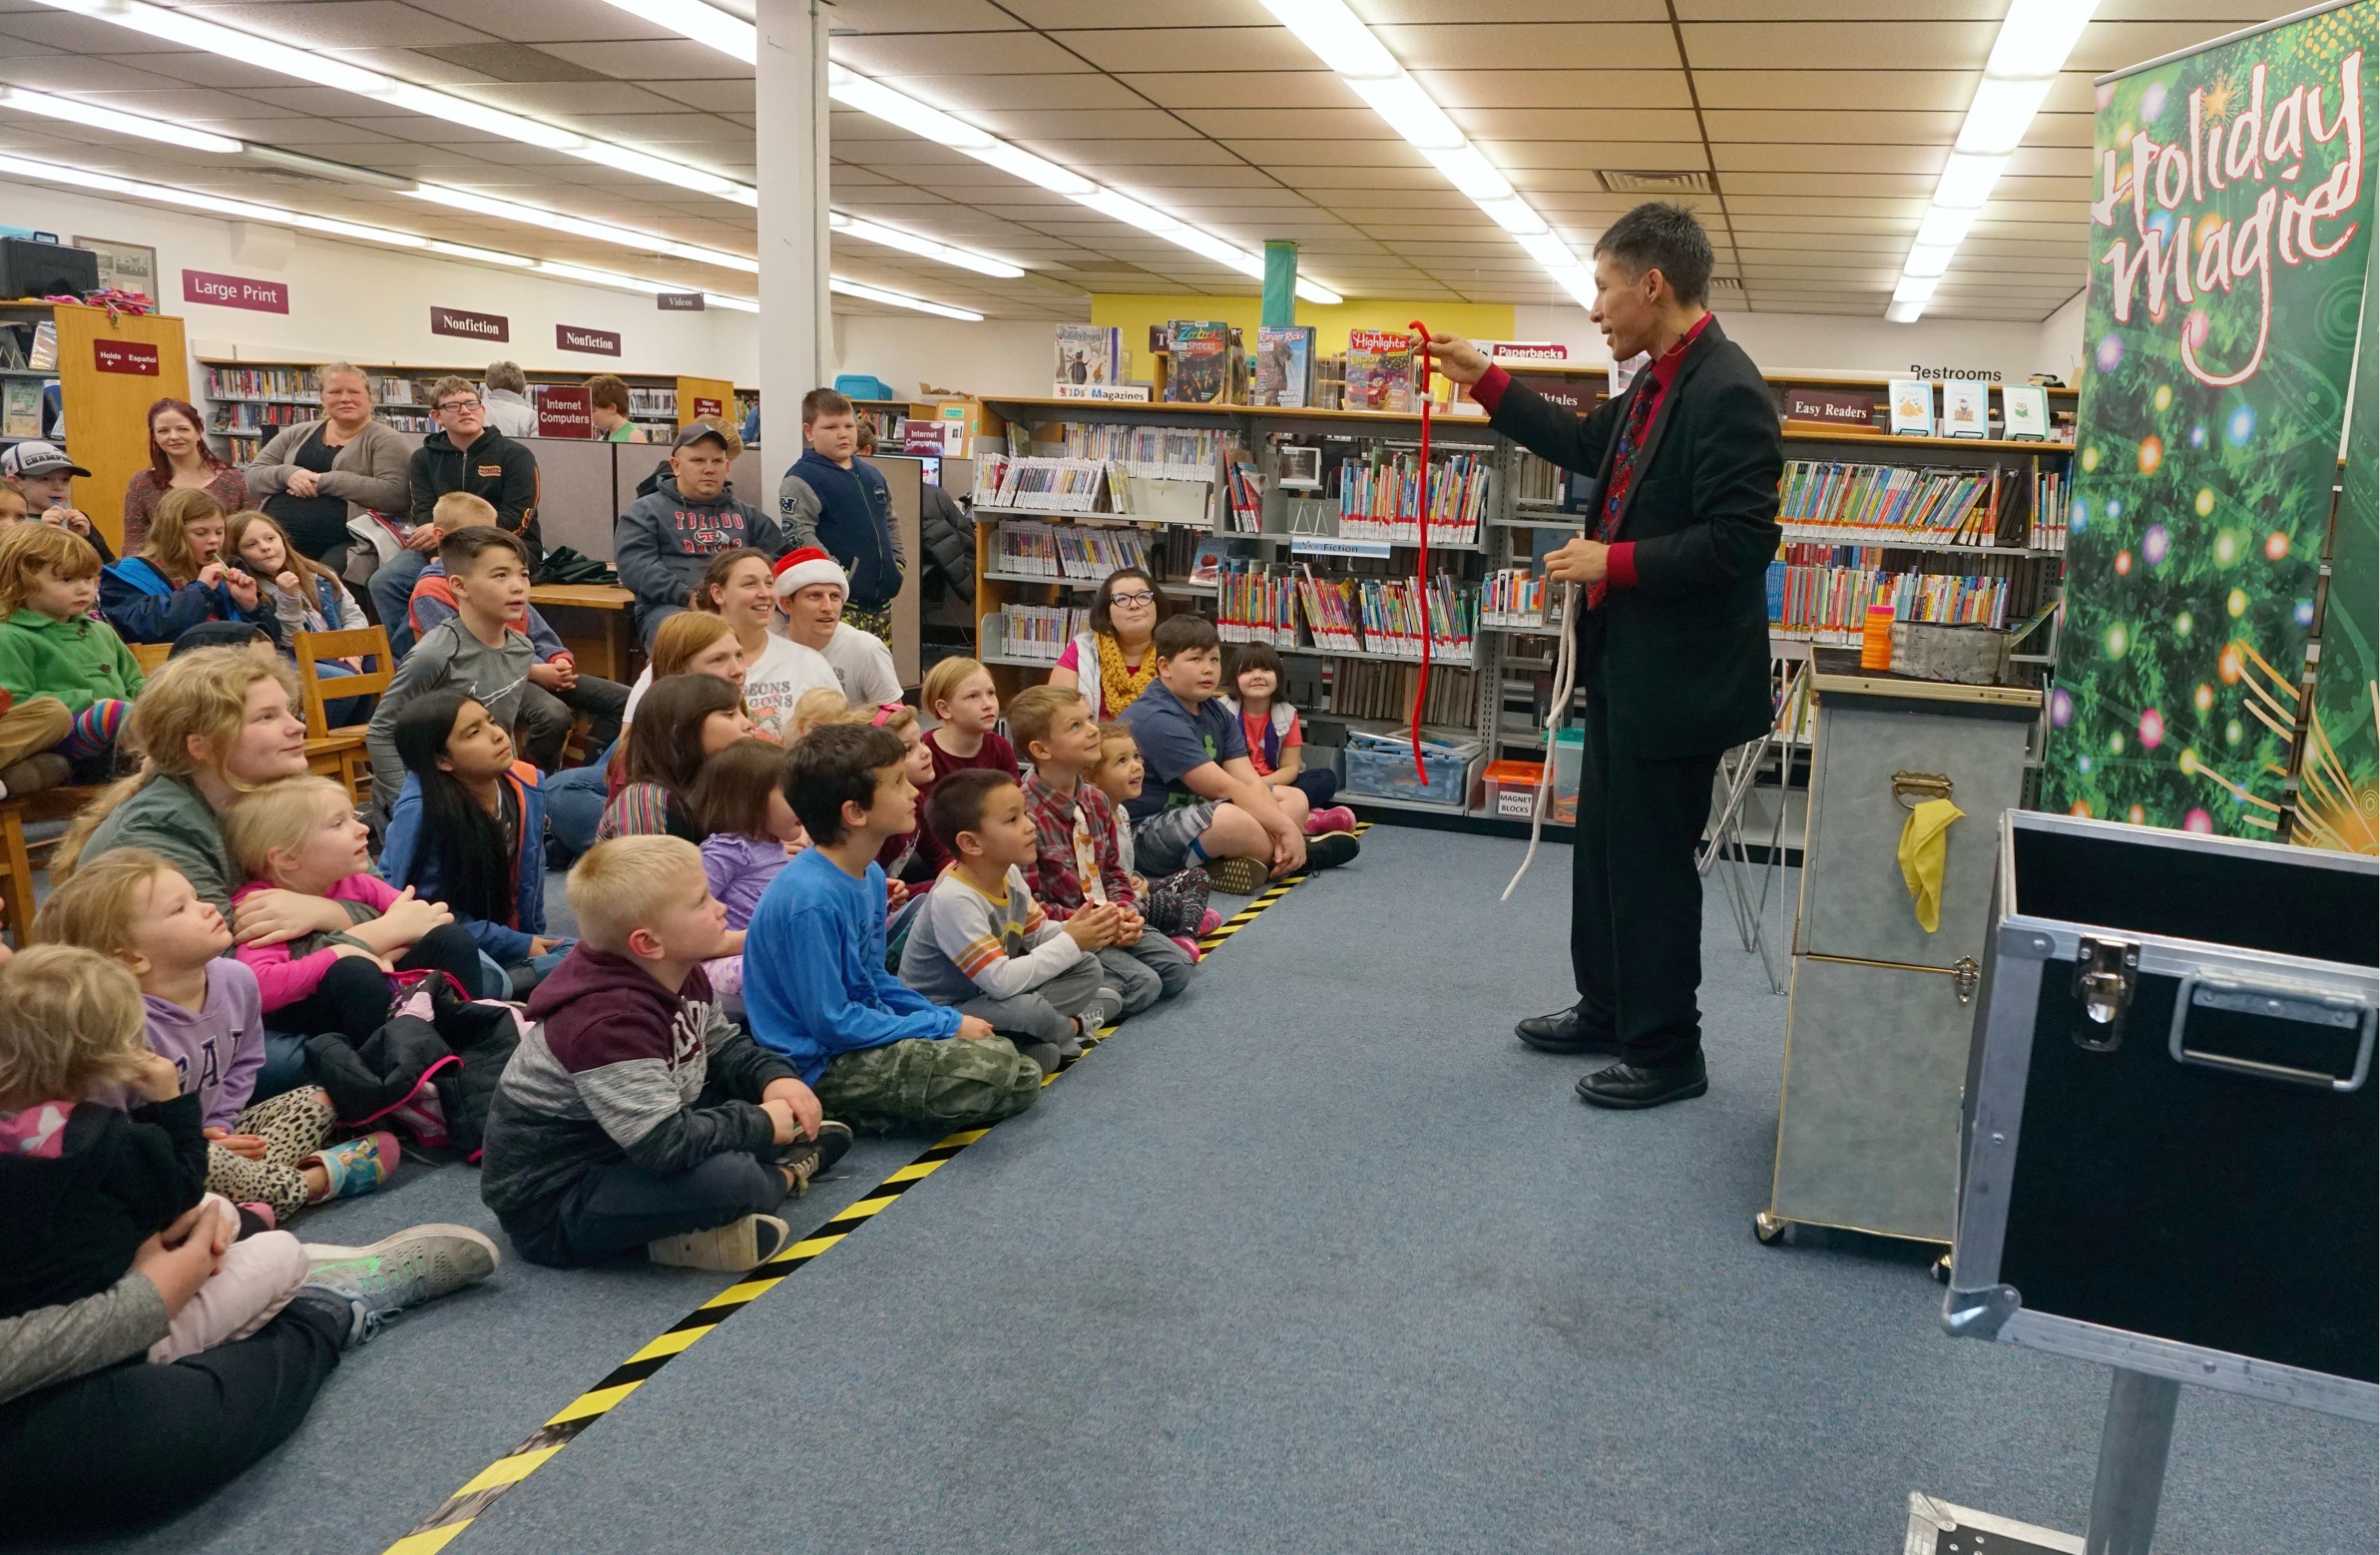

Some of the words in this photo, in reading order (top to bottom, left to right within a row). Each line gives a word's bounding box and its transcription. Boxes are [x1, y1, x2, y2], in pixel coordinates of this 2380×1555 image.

[2091, 49, 2364, 238] Holiday
[195, 277, 238, 300] Large
[243, 284, 277, 303] Print
[669, 296, 694, 307] Videos
[443, 314, 500, 335] Nonfiction
[566, 331, 613, 350] Nonfiction
[1259, 331, 1284, 342] Ranger
[1353, 332, 1406, 350] Highlights
[1188, 341, 1215, 350] SPIDERS
[100, 351, 122, 360] Holds
[129, 354, 157, 363] Español
[1499, 346, 1564, 359] Paperbacks
[1910, 364, 2002, 381] Restrooms
[1092, 388, 1145, 401] Magazines
[1540, 392, 1578, 406] ktales
[547, 398, 582, 411] Internet
[1795, 400, 1821, 416] Easy
[1825, 404, 1867, 419] Readers
[540, 411, 590, 426] Computers
[911, 429, 938, 438] Internet
[905, 439, 943, 448] Computers
[675, 511, 744, 530] TOLEDO
[1323, 543, 1358, 553] Fiction
[1500, 794, 1532, 803] MAGNET
